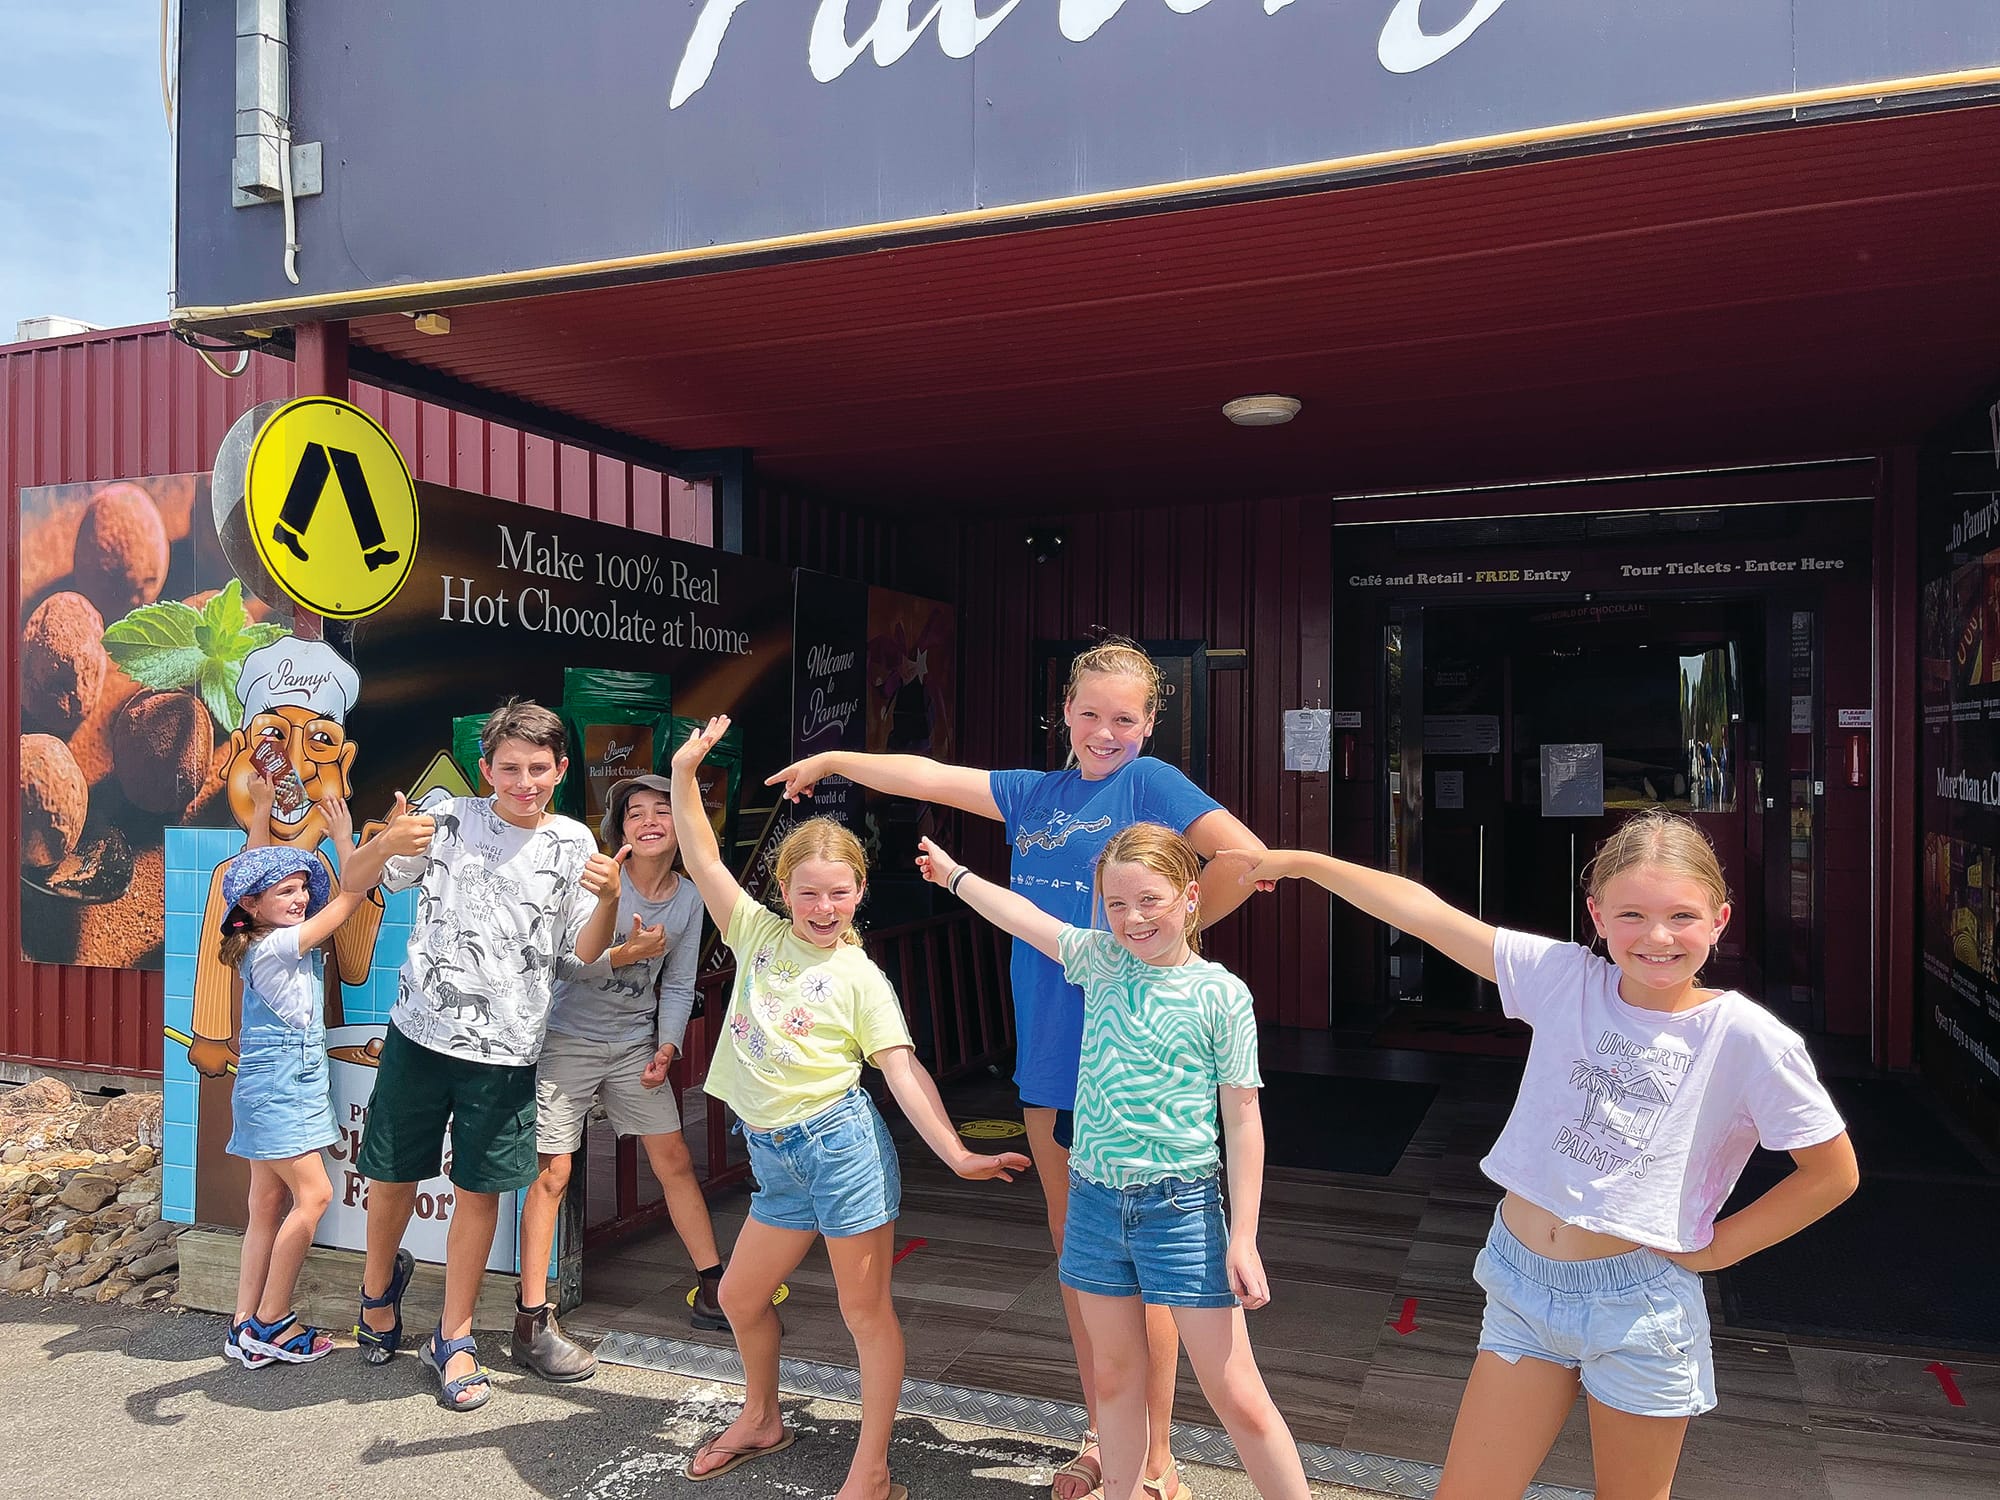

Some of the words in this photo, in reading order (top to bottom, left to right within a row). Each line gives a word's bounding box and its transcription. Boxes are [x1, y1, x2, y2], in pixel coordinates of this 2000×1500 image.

[497, 524, 584, 582] Make
[594, 552, 664, 596] 100%
[670, 560, 720, 605] Real
[1349, 574, 1382, 587] Café
[1385, 574, 1414, 586] and
[1417, 572, 1464, 585] Retail
[1475, 570, 1520, 583] FREE
[1523, 569, 1572, 583] Entry
[1620, 564, 1662, 577] Tour
[1665, 562, 1731, 575] Tickets
[1745, 559, 1797, 572] Enter
[1800, 557, 1845, 571] Here
[440, 575, 509, 628] Hot
[517, 587, 656, 645] Chocolate
[662, 621, 686, 648] at
[690, 611, 753, 656] home.
[268, 658, 333, 694] Pannys
[806, 644, 855, 682] Welcome
[802, 687, 861, 737] Pannys
[589, 766, 604, 777] Real
[605, 766, 618, 777] Hot
[1958, 769, 1980, 803] than
[815, 791, 837, 805] world
[838, 789, 847, 804] of
[475, 841, 504, 856] JUNGLE
[481, 850, 500, 863] VIBES
[1595, 1030, 1669, 1067] UNDER
[1551, 1125, 1608, 1171] PALM
